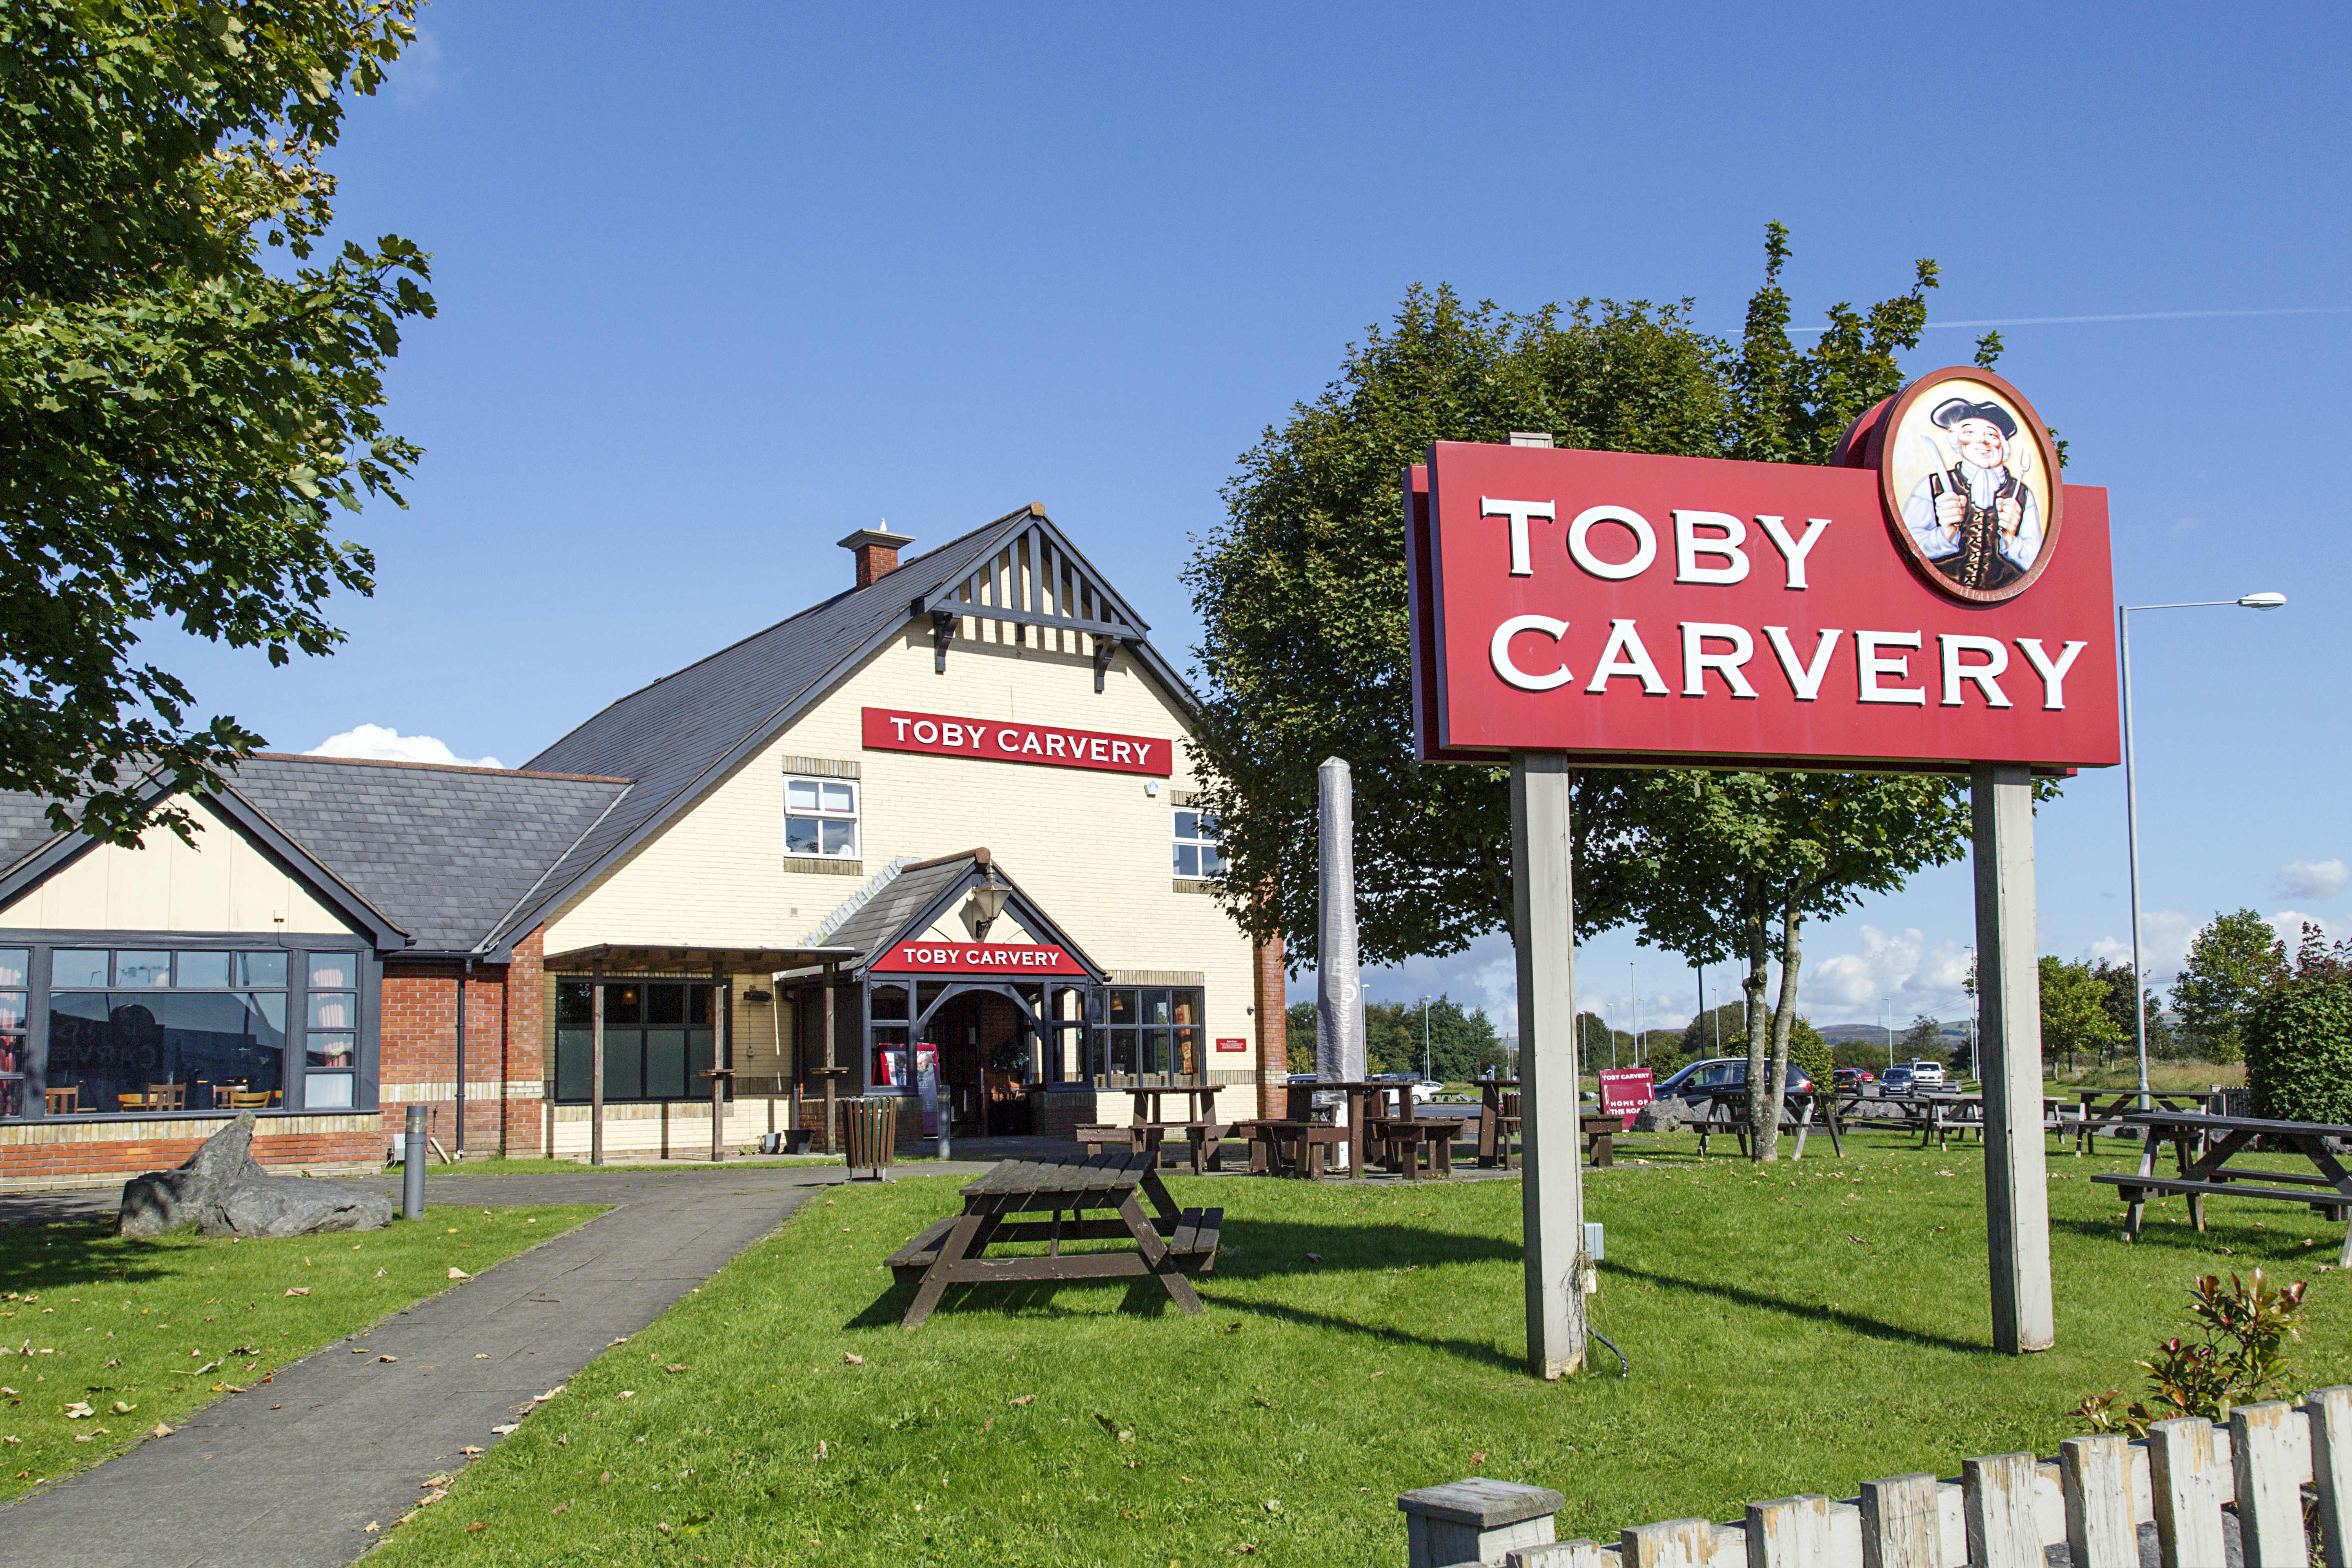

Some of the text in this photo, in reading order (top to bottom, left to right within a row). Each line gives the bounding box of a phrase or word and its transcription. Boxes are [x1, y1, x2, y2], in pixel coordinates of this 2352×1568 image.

[1481, 495, 1832, 588] TOBY
[1491, 615, 2088, 709] CARVERY
[890, 716, 1152, 765] TOBY CARVERY
[903, 948, 1060, 966] TOBY CARVERY
